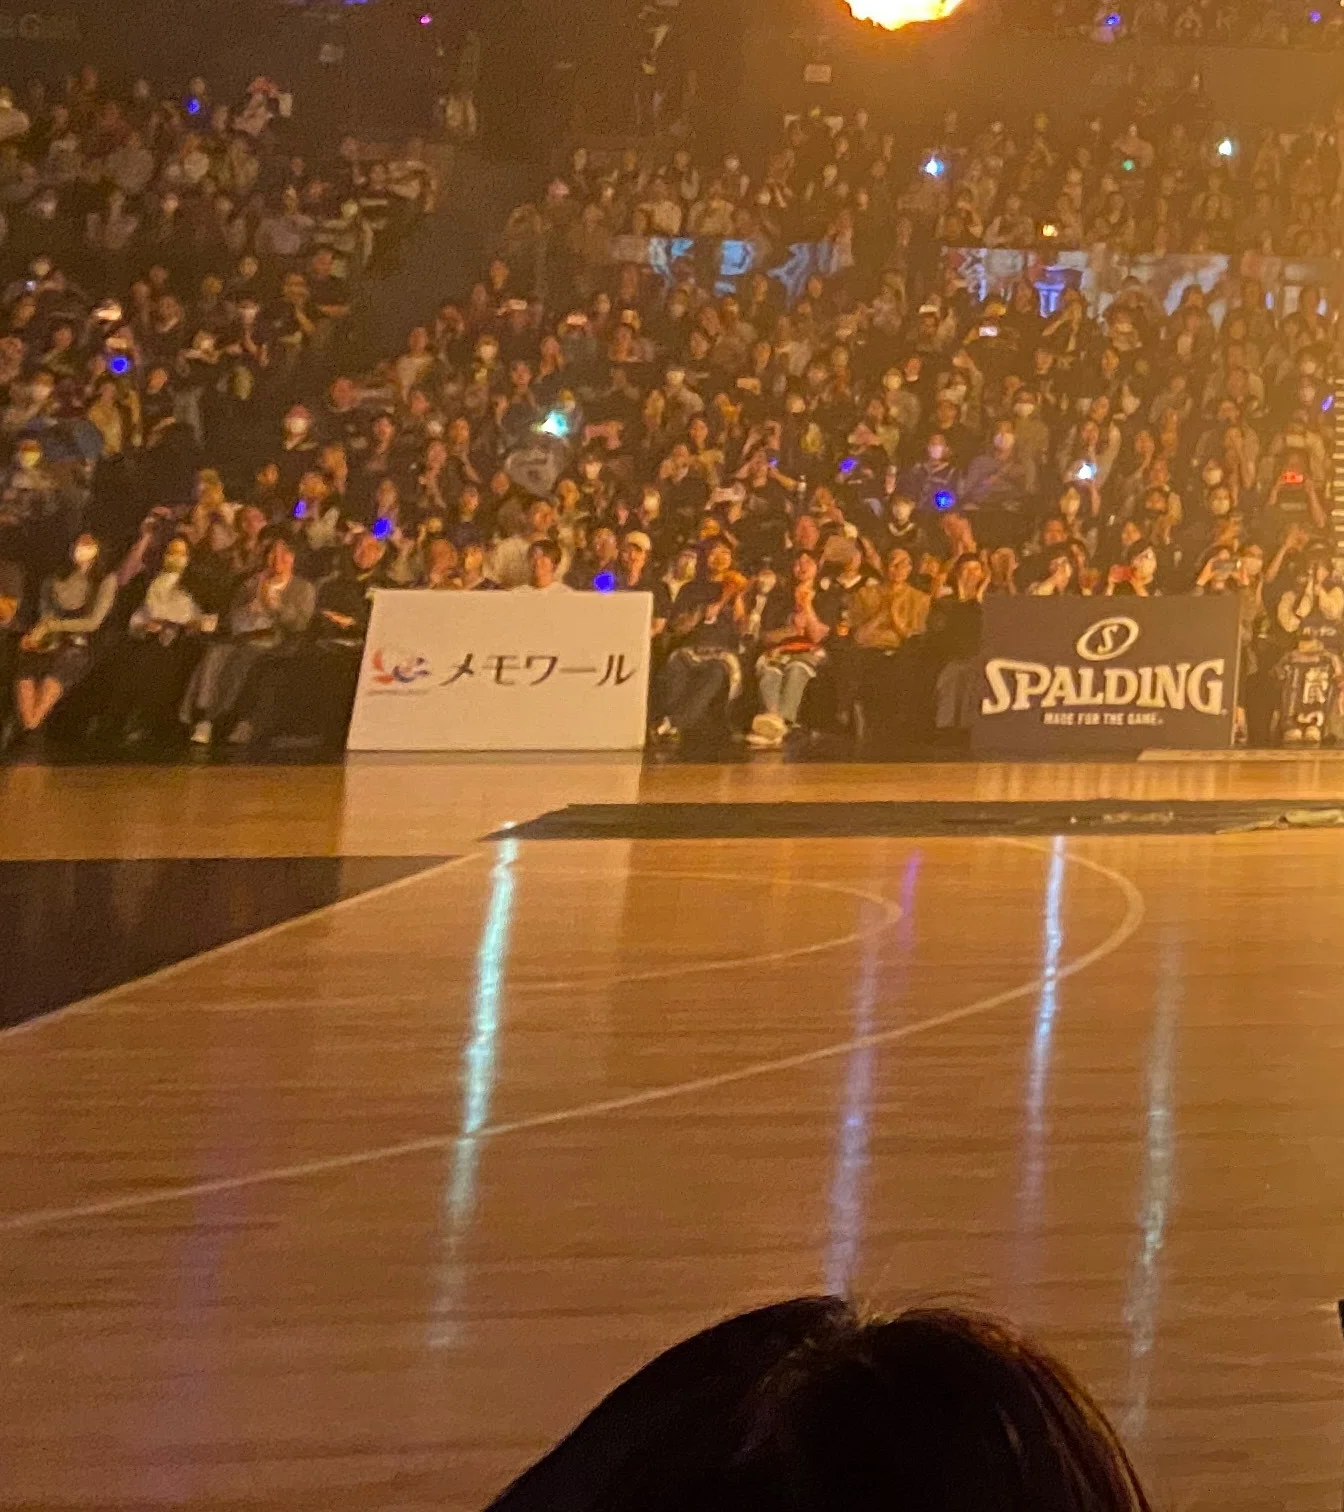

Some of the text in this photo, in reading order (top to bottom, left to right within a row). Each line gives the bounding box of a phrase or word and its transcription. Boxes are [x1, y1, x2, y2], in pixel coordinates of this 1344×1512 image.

[439, 652, 636, 687] メモワール
[981, 657, 1225, 716] SPALDING
[1077, 712, 1100, 725] FOR
[1103, 712, 1125, 725] THE
